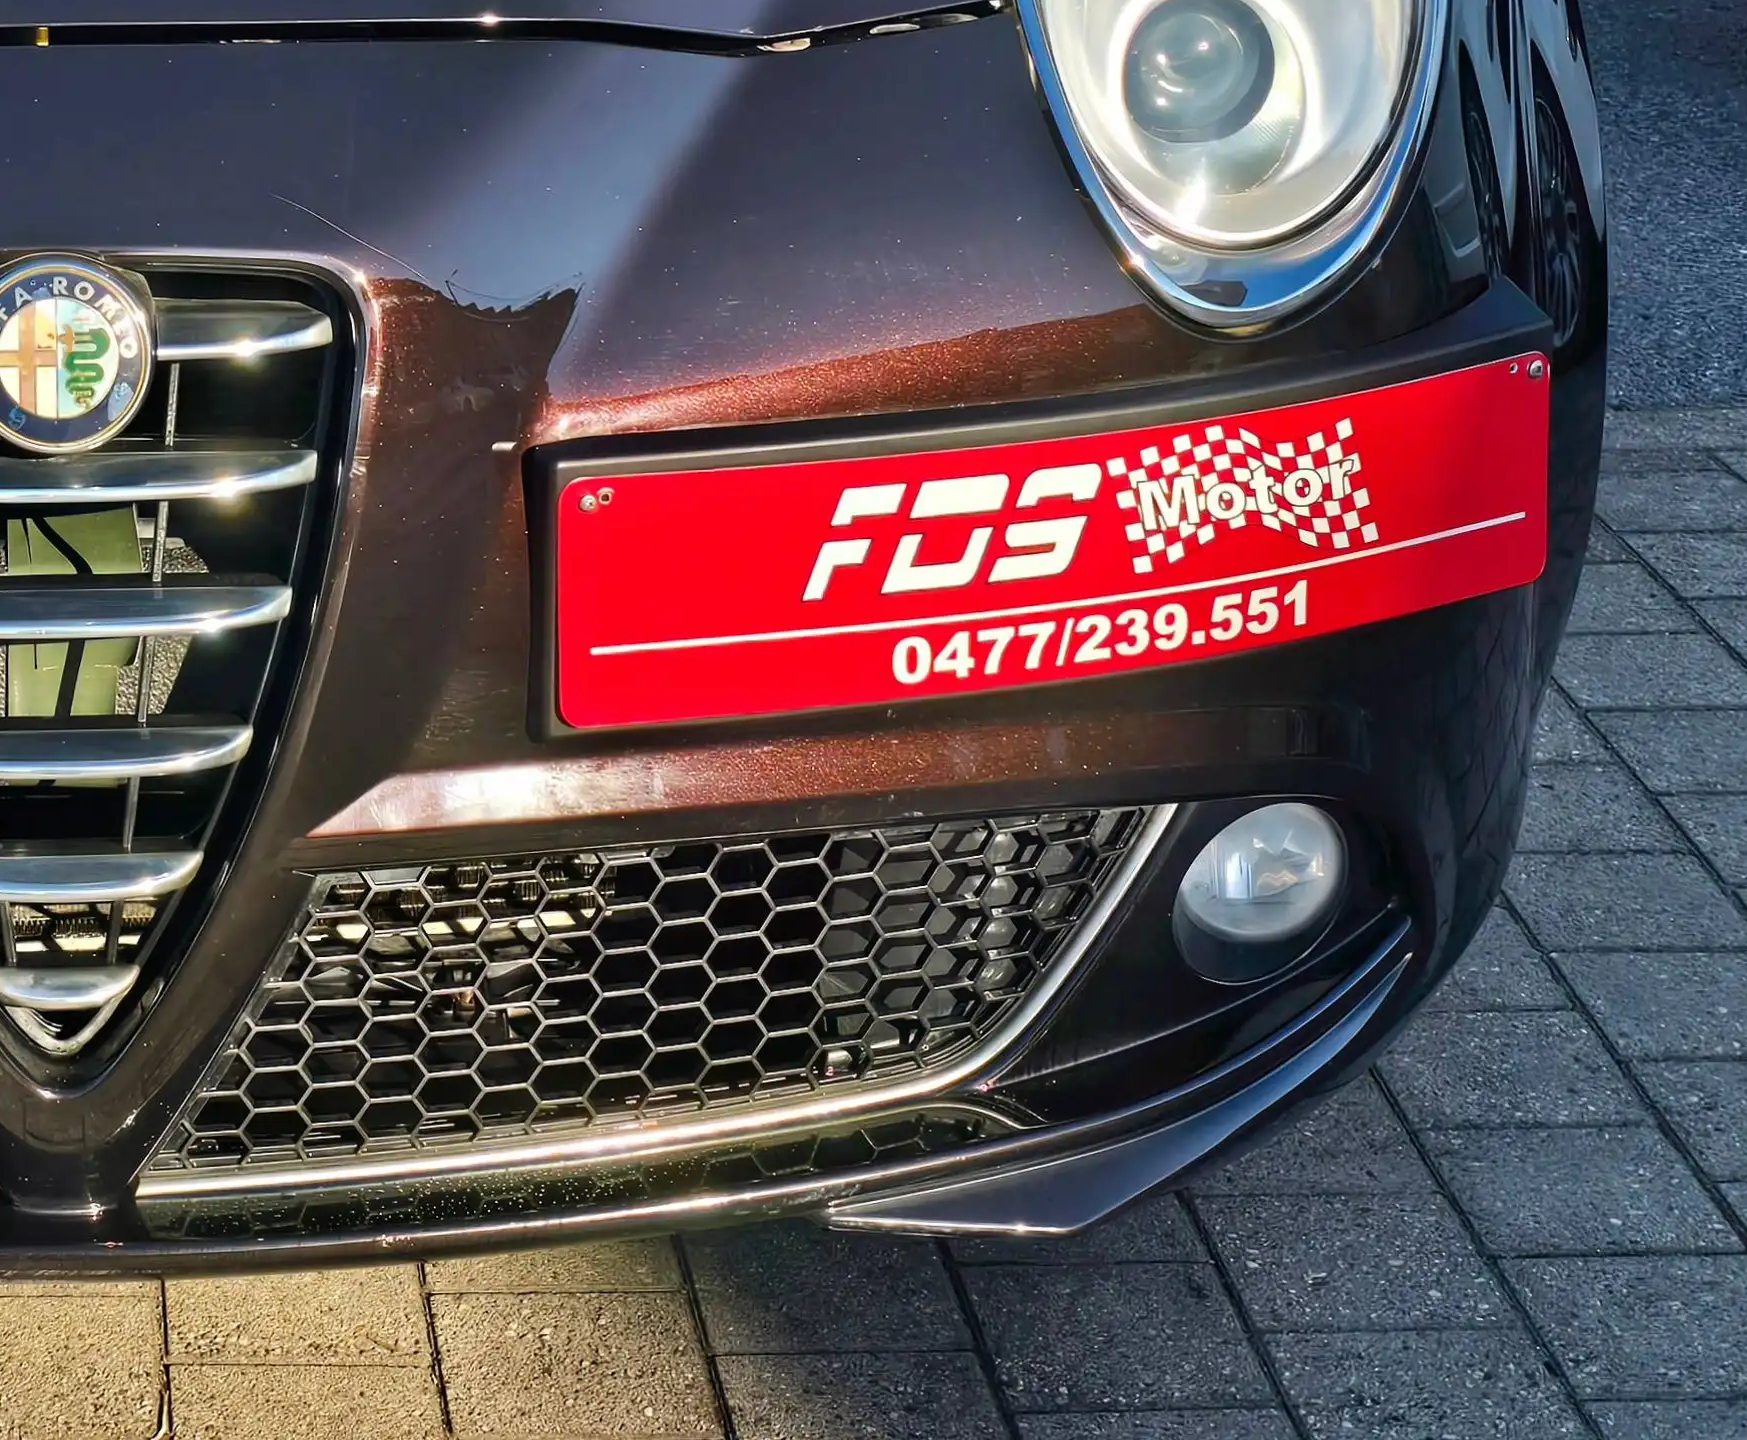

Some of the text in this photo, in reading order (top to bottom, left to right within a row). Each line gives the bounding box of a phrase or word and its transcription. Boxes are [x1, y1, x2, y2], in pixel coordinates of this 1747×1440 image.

[52, 276, 138, 359] ROMEO
[802, 458, 1355, 602] FOS Motor
[891, 579, 1309, 684] 0477/239.551
